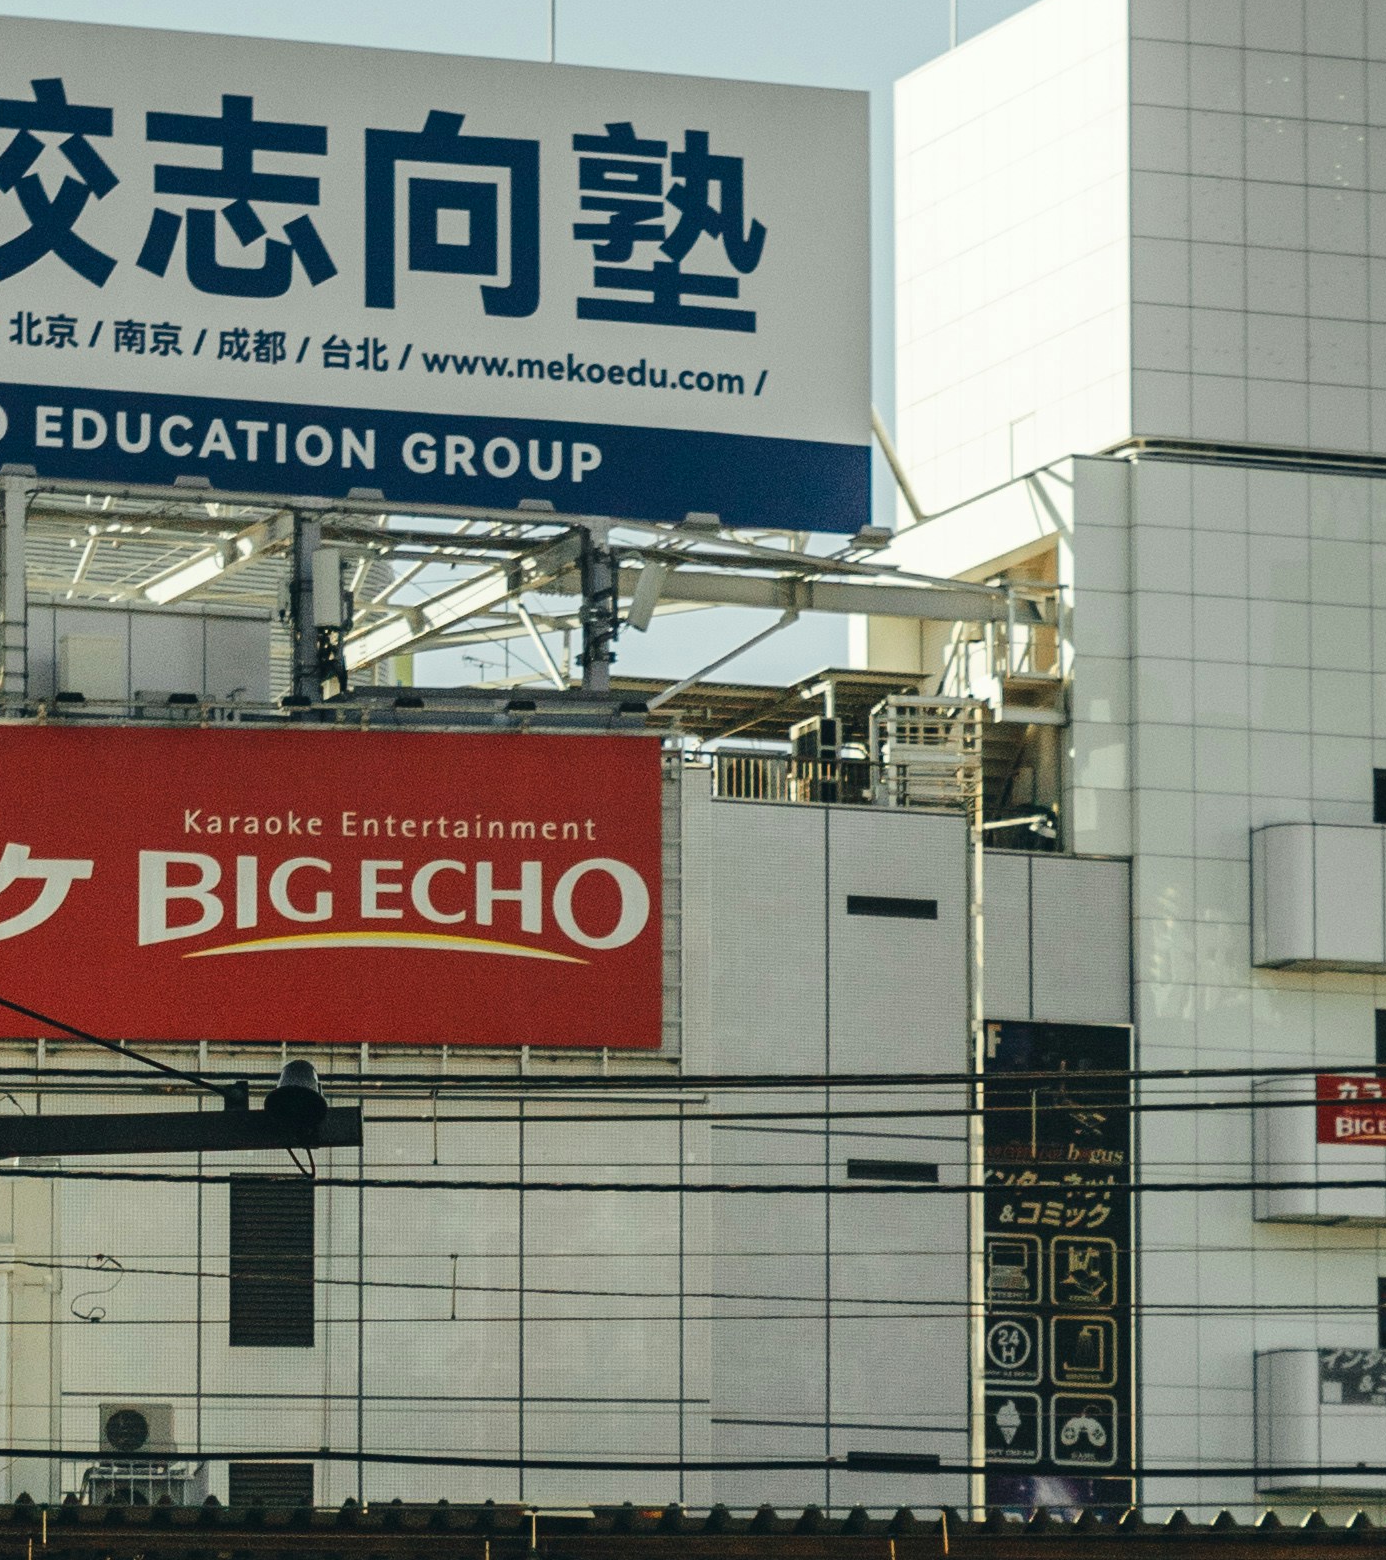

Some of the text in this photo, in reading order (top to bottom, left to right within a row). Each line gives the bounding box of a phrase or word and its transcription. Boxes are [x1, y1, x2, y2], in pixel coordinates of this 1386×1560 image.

[9, 312, 78, 348] 北京
[114, 321, 183, 356] 南京
[217, 328, 286, 364] 成都
[321, 335, 389, 371] 台北
[422, 350, 745, 395] www.mekoedu.com
[36, 406, 377, 471] EDUCATION
[402, 432, 604, 484] GROUP
[183, 809, 597, 842] Karaoke Entertainment
[138, 849, 651, 950] BIG ECHO
